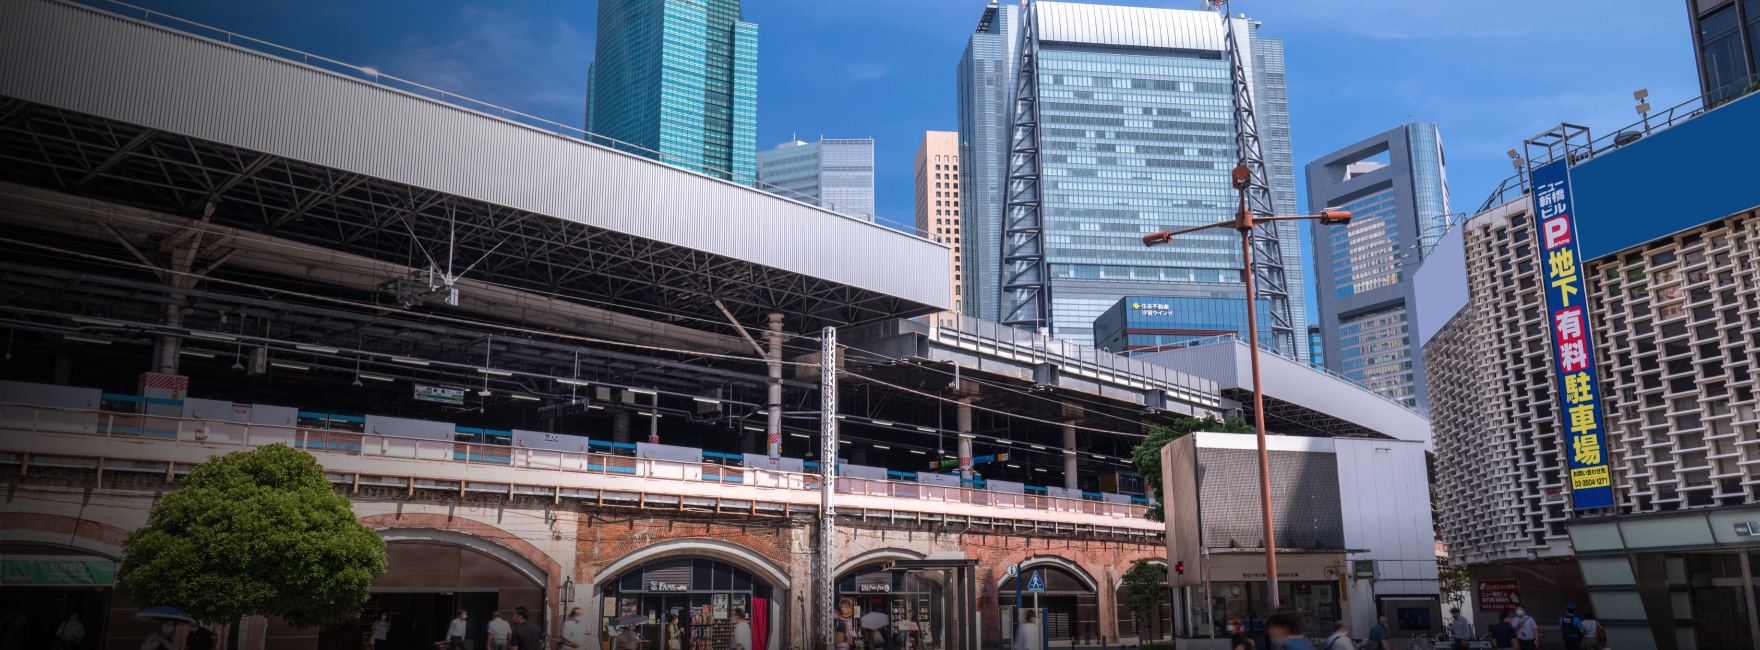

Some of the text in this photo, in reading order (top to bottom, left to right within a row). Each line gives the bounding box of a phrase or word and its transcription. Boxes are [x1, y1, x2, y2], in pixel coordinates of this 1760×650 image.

[1538, 181, 1564, 196] ニュー
[1539, 188, 1565, 208] 新橋
[1541, 203, 1567, 219] ビル
[1572, 468, 1607, 478] お問い合わせ先
[1574, 477, 1608, 488] 03-3504-1271
[50, 563, 87, 571] 日比谷口
